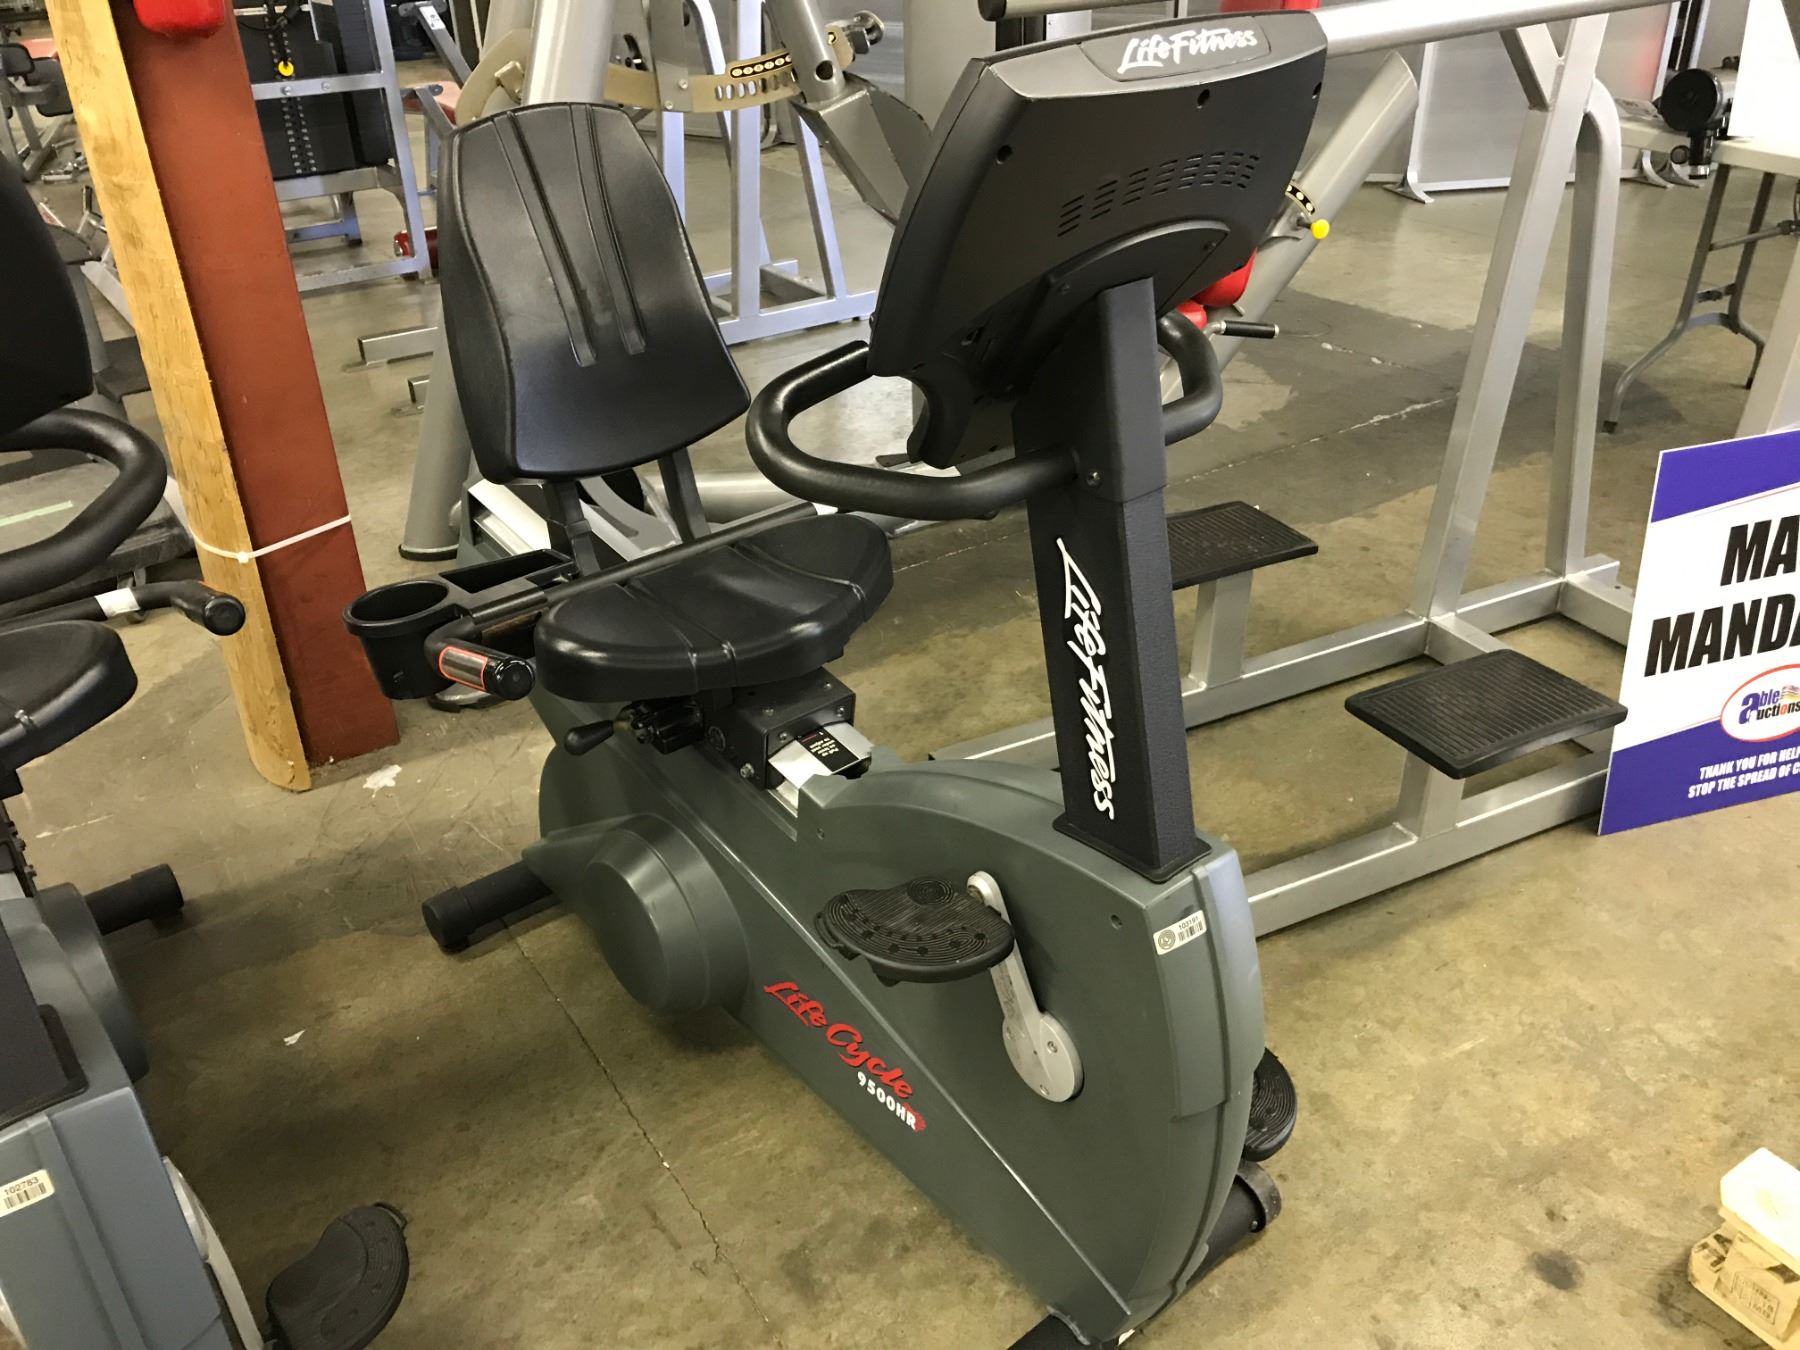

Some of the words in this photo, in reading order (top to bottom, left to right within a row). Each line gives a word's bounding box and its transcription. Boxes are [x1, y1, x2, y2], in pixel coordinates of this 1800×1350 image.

[1688, 780, 1716, 798] STOP
[1717, 776, 1737, 792] THE
[1737, 767, 1778, 787] SPREAD
[1778, 763, 1792, 778] OF
[1700, 760, 1735, 780] THANK
[1736, 755, 1757, 772] YOU
[1757, 751, 1778, 767] FOR
[857, 1071, 917, 1130] 9500HR
